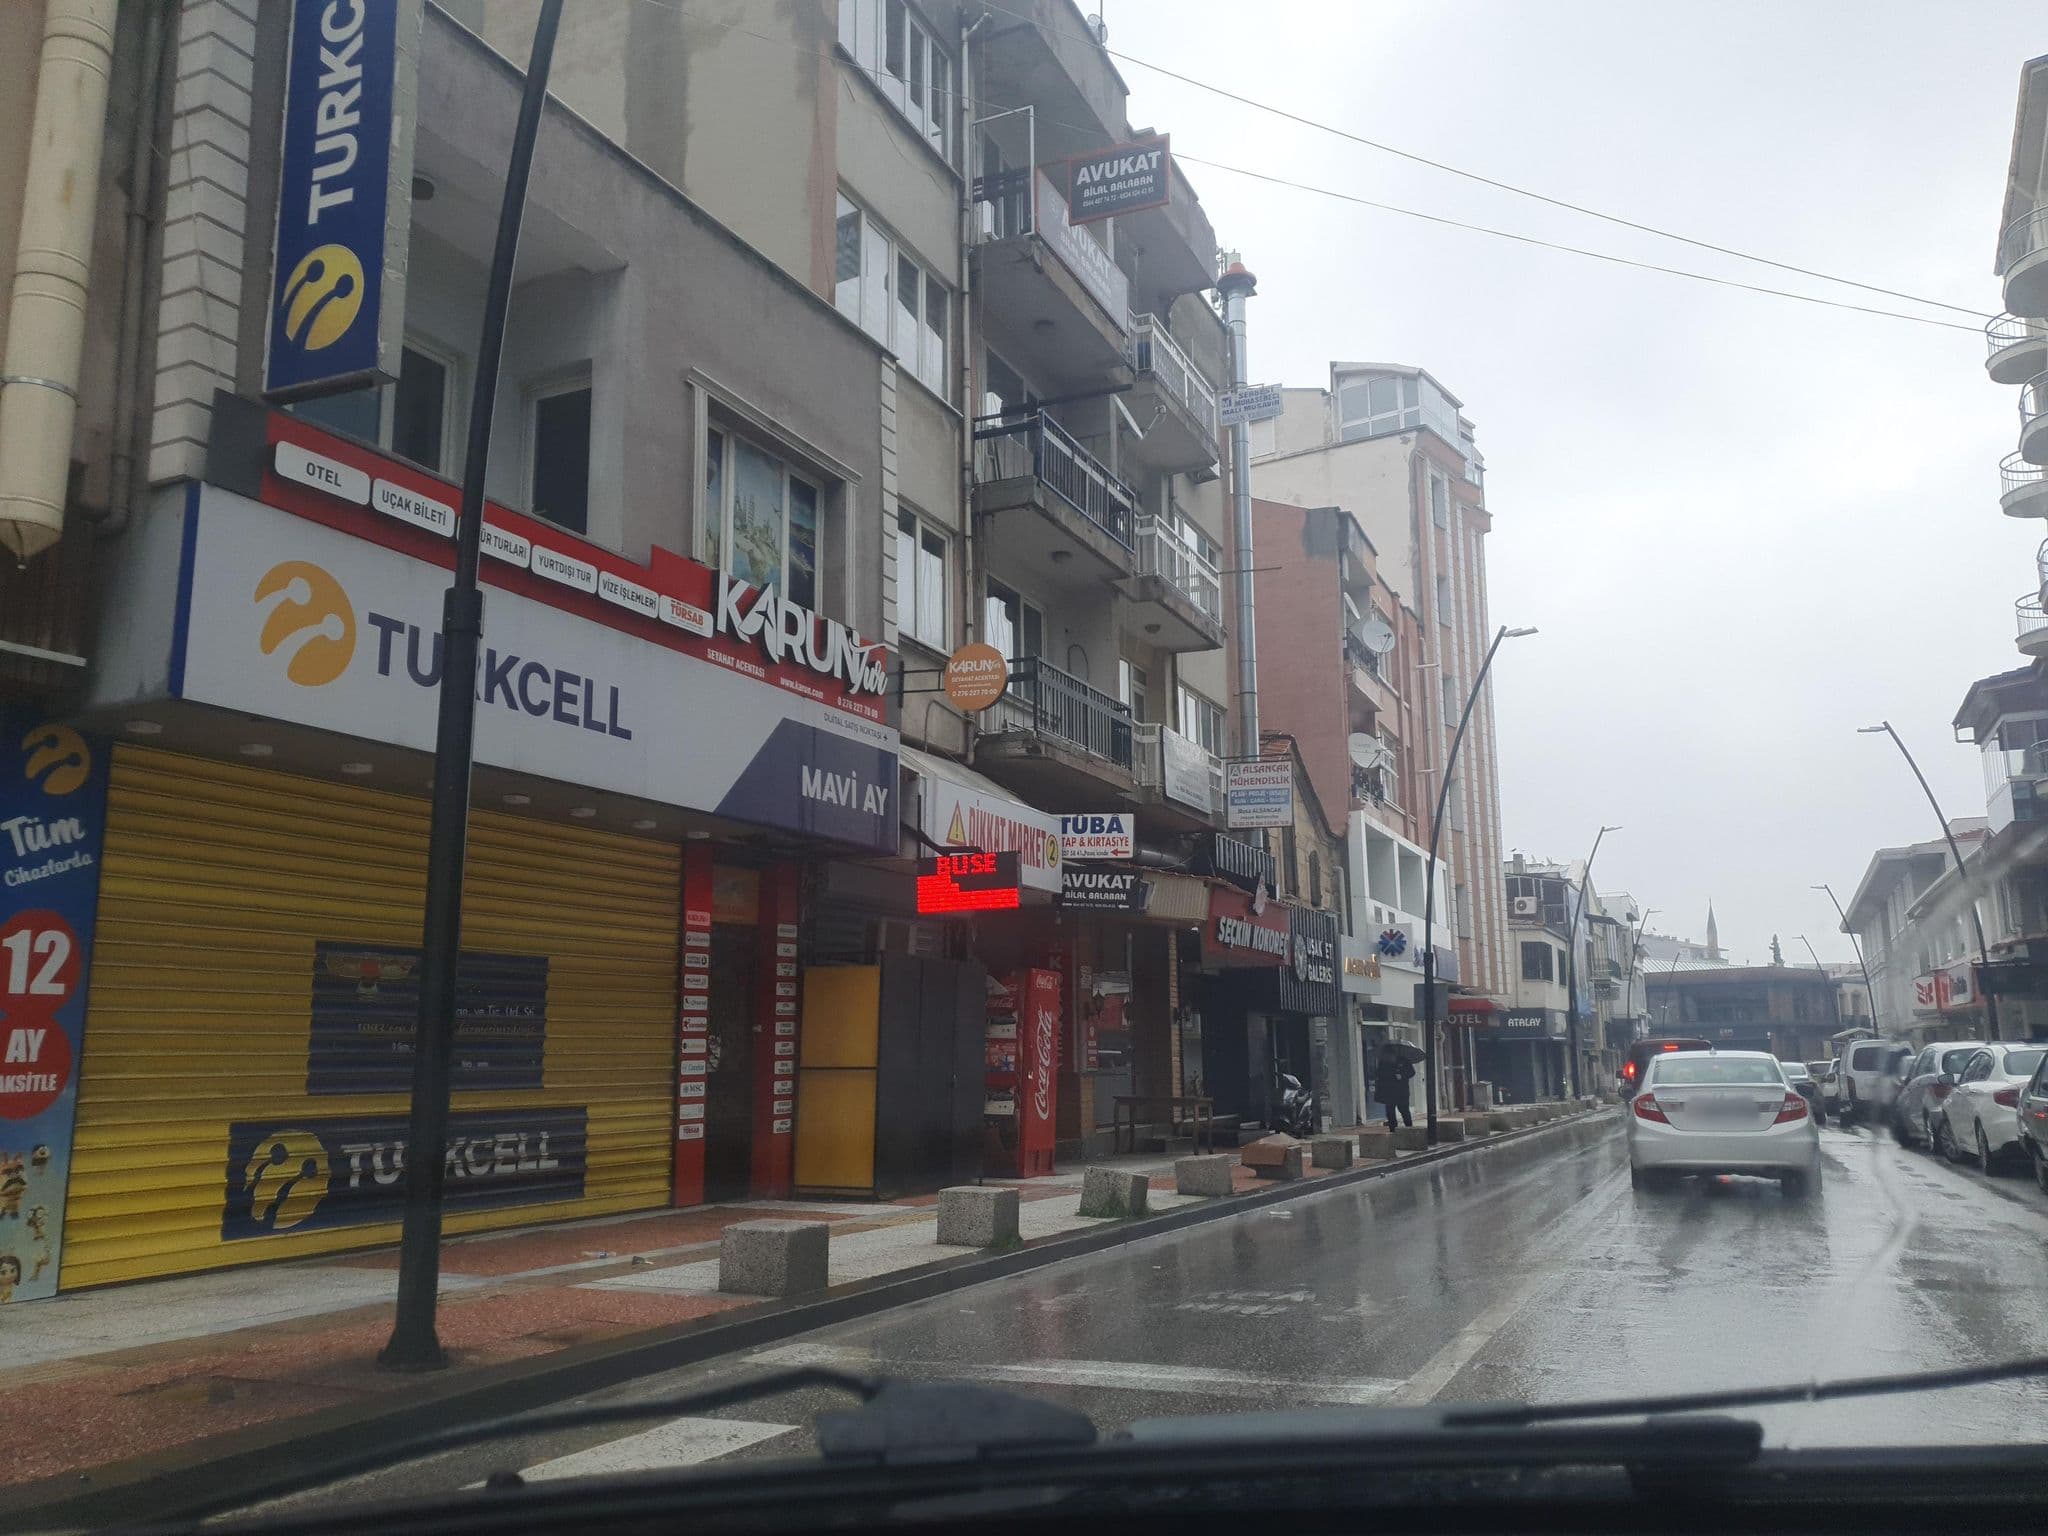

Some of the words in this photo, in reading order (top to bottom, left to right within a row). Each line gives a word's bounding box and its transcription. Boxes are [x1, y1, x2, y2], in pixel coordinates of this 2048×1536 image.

[1076, 150, 1162, 186] AVUKAT
[1083, 183, 1108, 197] BİLAL
[1110, 175, 1154, 192] BALABAN
[306, 462, 342, 488] OTEL
[382, 489, 412, 512] UÇAK
[413, 501, 447, 526] BİLETİ
[493, 536, 528, 560] TURLARI
[538, 554, 576, 580] YURTDIŞI
[576, 567, 592, 584] TUR
[602, 577, 619, 596] VİZE
[619, 583, 658, 610] İŞLEMLERİ
[717, 570, 861, 681] KARUN
[707, 648, 735, 666] SEYAHAT
[949, 659, 993, 674] KARUN
[368, 611, 632, 741] TUKCELL
[1243, 764, 1289, 773] ALSANCAK
[801, 764, 857, 809] MAVİ
[863, 785, 888, 816] AY
[1, 815, 86, 857] Tüm
[968, 800, 1006, 852] DİKKAT
[1008, 819, 1047, 870] MARKET
[1079, 837, 1086, 847] &
[1087, 836, 1129, 847] KIRTASİYE
[5, 850, 94, 888] Cihazlarda
[1062, 873, 1134, 890] AVUKAT
[1065, 890, 1088, 900] BİLAL
[1088, 891, 1127, 901] BALABAN
[2, 929, 71, 995] 12
[1251, 925, 1291, 966] KOKOREÇ
[1508, 1017, 1541, 1027] ATALAY
[5, 1029, 46, 1064] AY
[341, 1131, 559, 1188] TUKCELL
